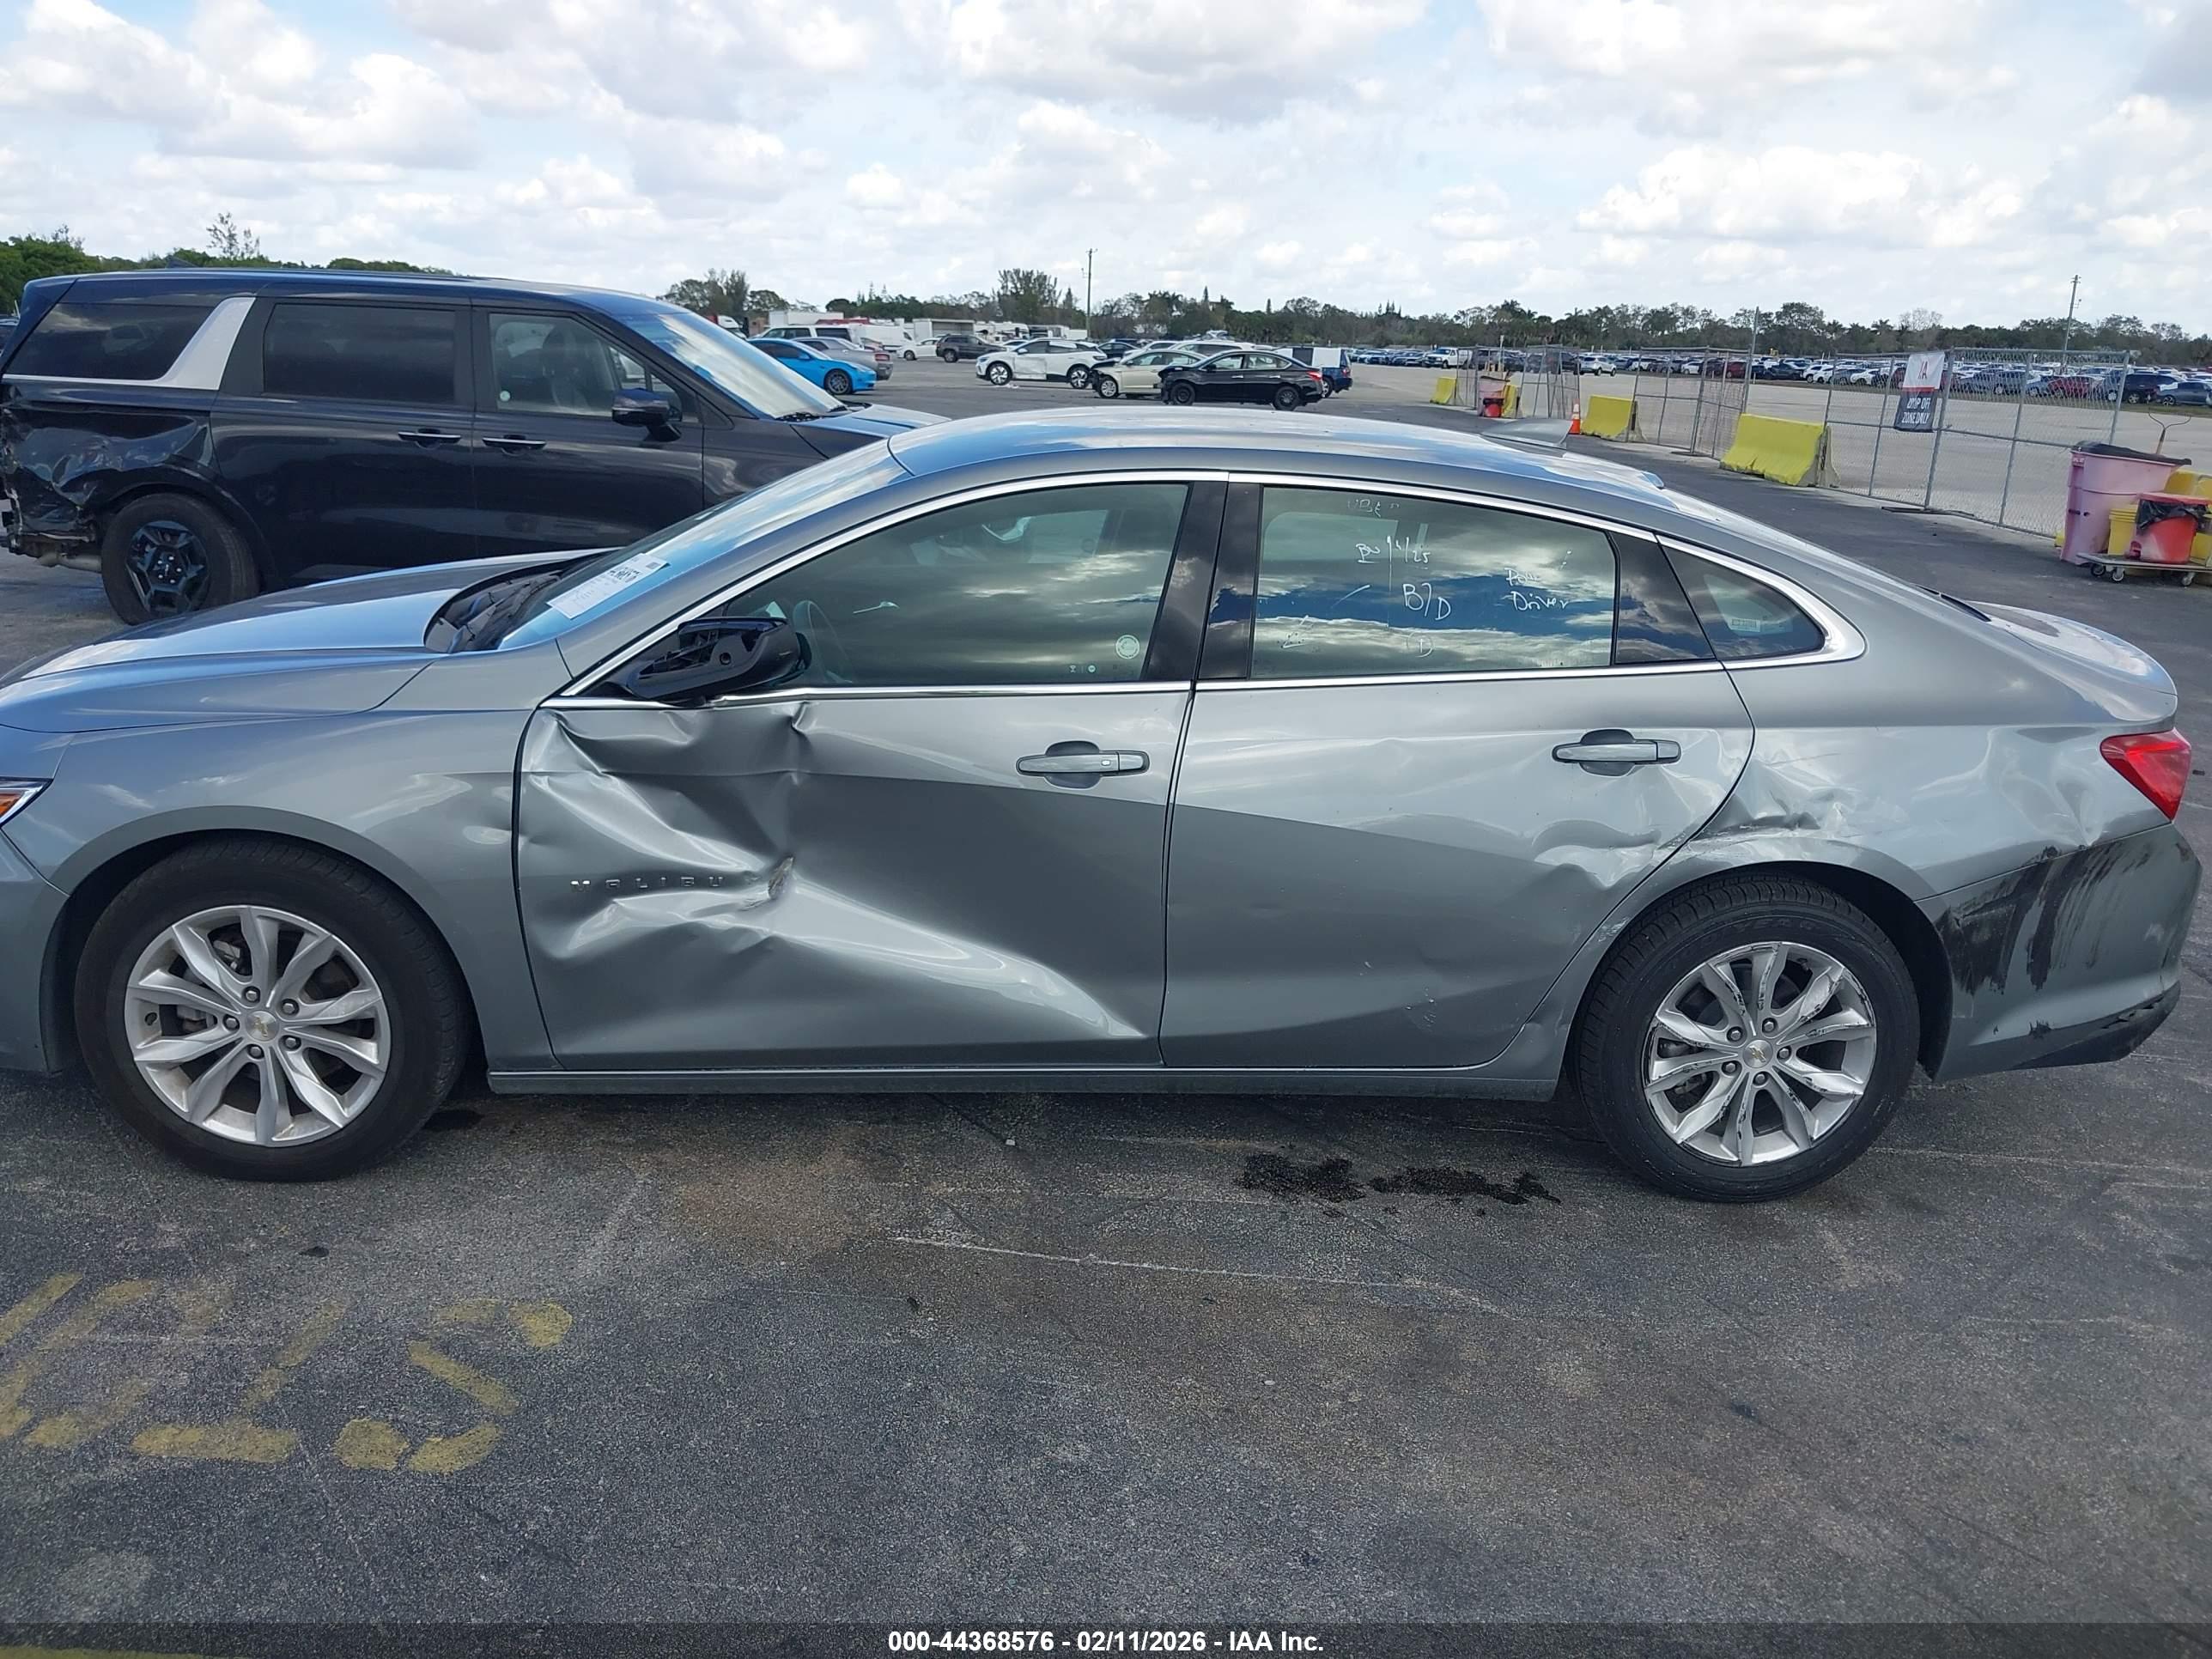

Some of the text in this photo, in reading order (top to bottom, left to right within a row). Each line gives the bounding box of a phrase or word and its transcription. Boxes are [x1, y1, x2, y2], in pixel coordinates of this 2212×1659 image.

[1906, 398, 1931, 410] DROP OFF
[1902, 411, 1930, 424] ZONE ONLY
[1402, 582, 1452, 621] B/D
[1510, 590, 1569, 611] Driver
[570, 876, 724, 892] MALIBU
